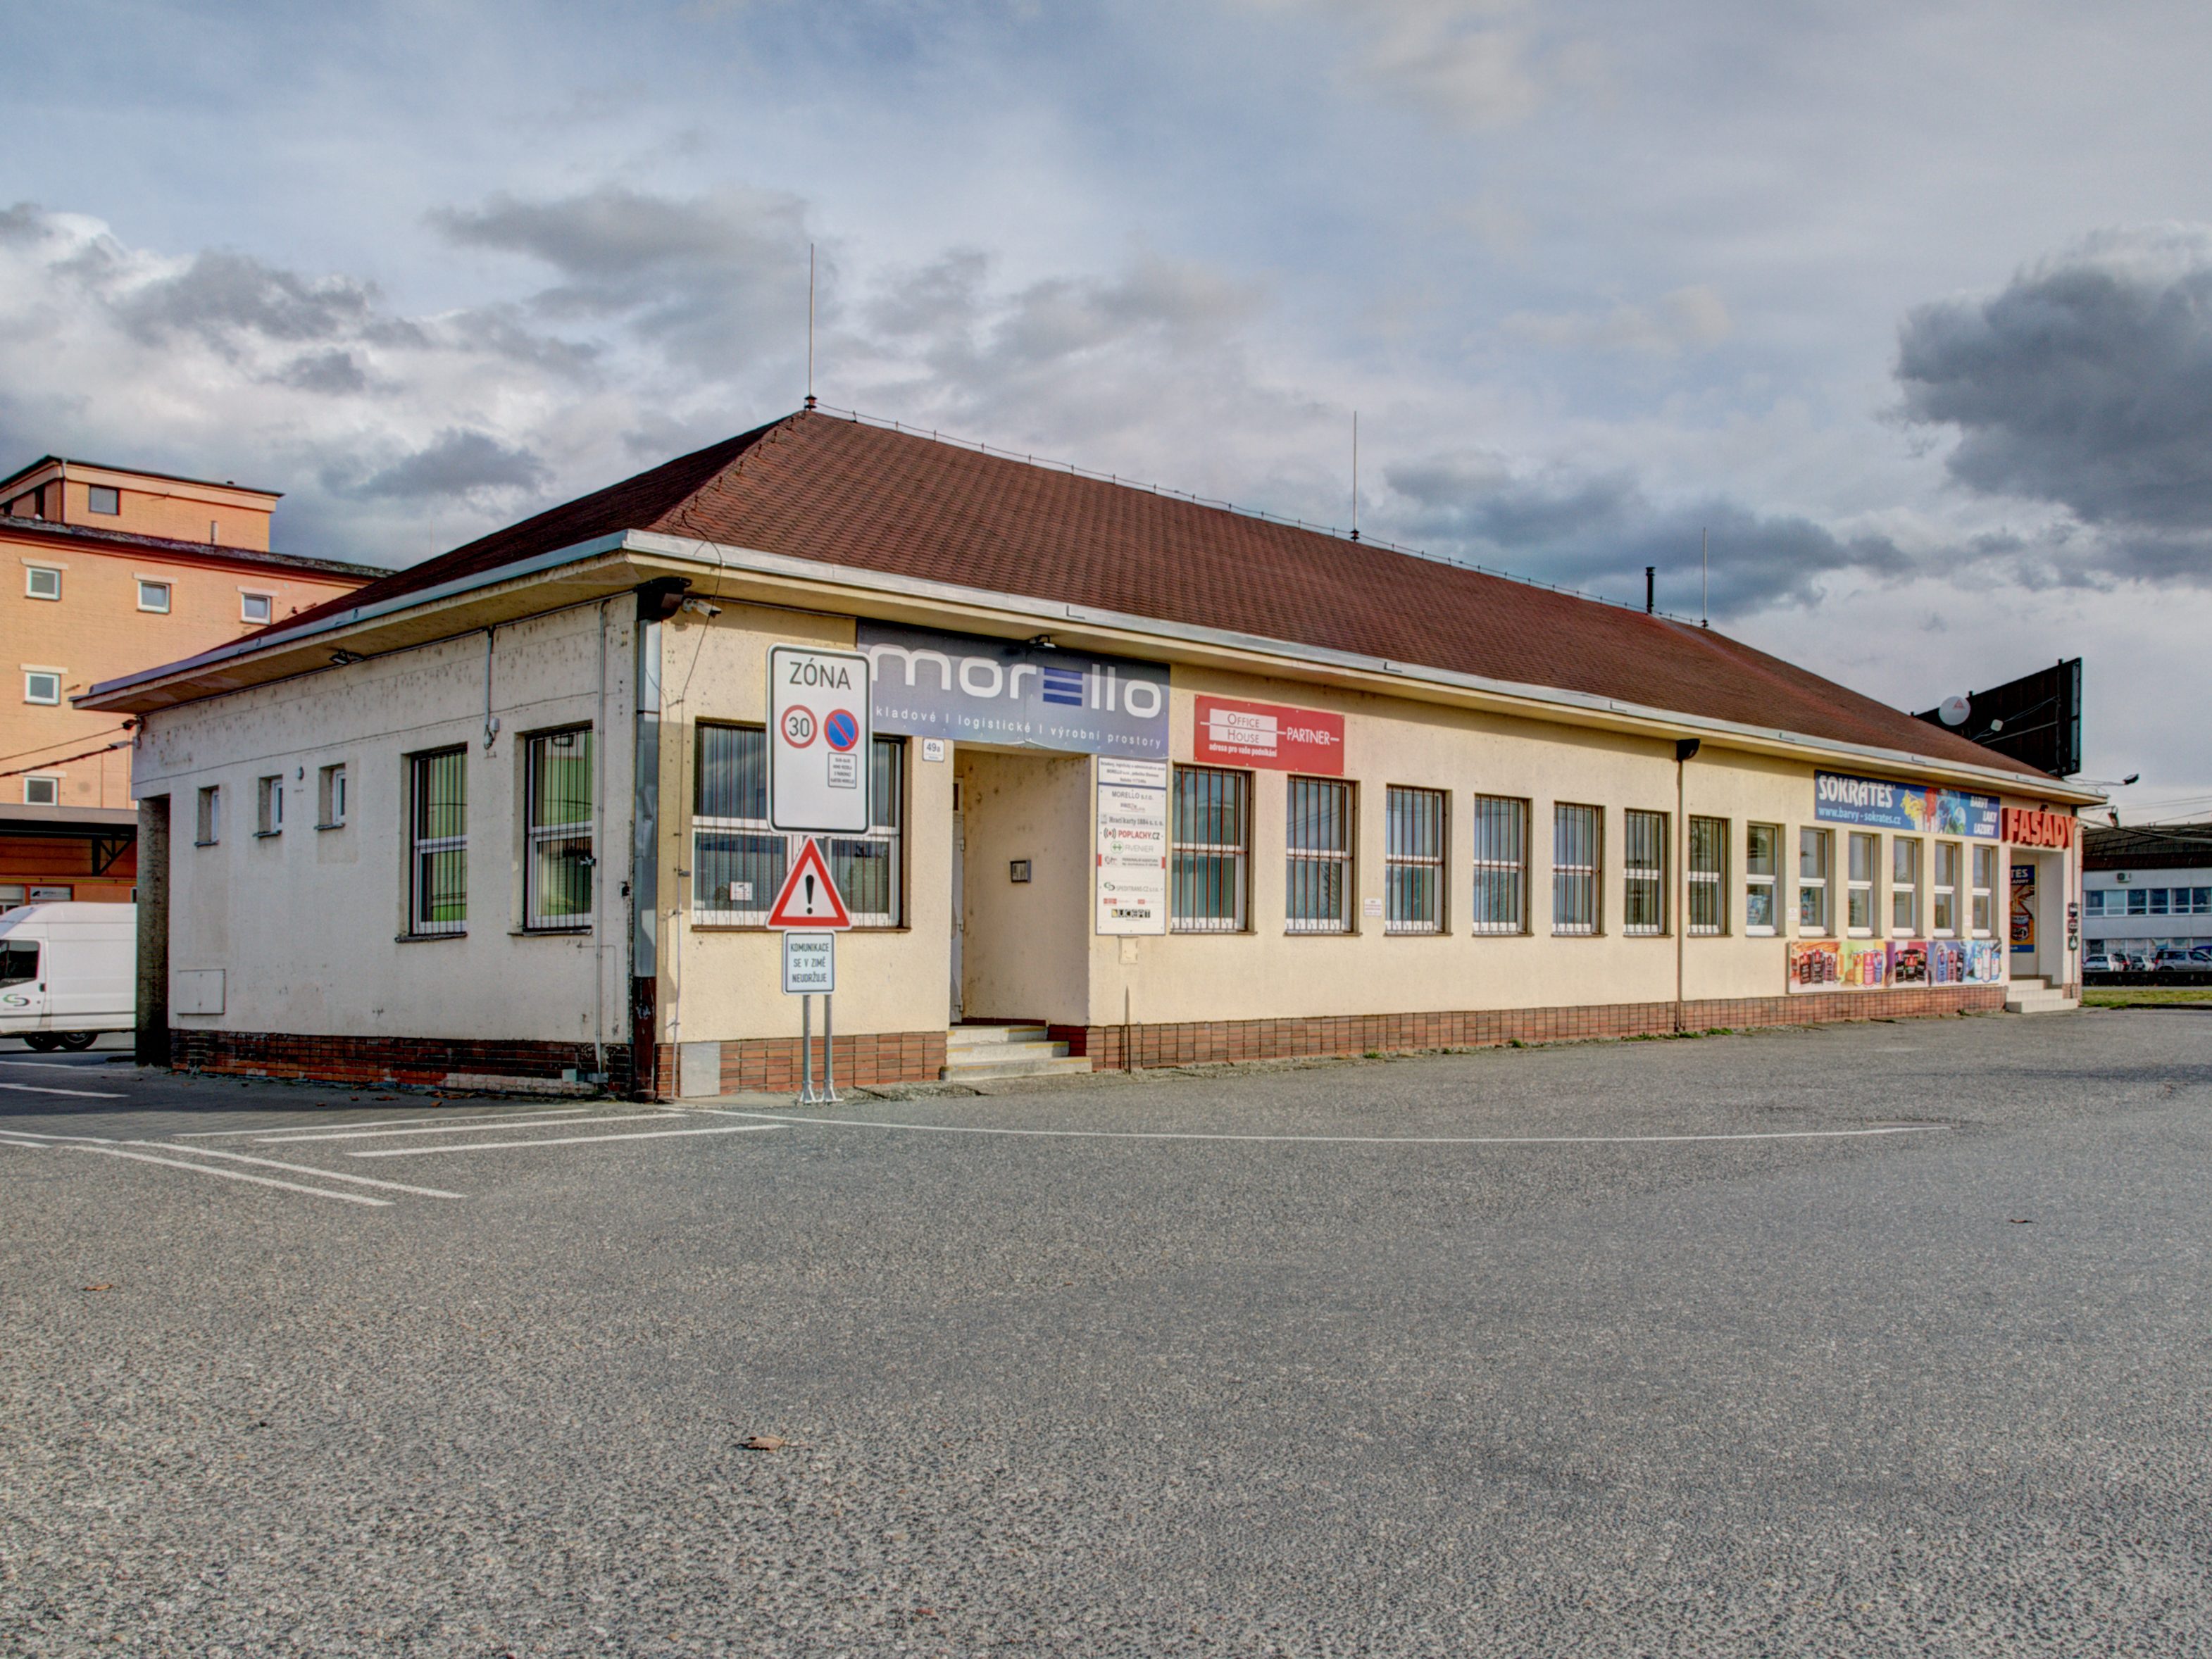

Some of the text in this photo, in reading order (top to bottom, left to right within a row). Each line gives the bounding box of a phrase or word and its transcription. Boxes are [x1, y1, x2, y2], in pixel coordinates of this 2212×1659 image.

[789, 658, 851, 690] ZÓNA
[789, 717, 810, 737] 30
[876, 705, 1161, 749] kladové logistické výrobní prostory
[1287, 726, 1330, 745] PARTNER
[927, 742, 941, 752] 49a
[1208, 743, 1227, 753] adresa
[1228, 745, 1237, 753] pro
[1111, 791, 1139, 799] MORELLO
[1818, 775, 1894, 808] SOKRATES
[1118, 830, 1161, 840] POPLACHY.CZ
[2011, 869, 2028, 879] TES
[790, 943, 830, 952] KOMUNIKACE
[793, 956, 826, 968] SE V ZIMĚ
[792, 971, 827, 983] NEUDRŽUJE
